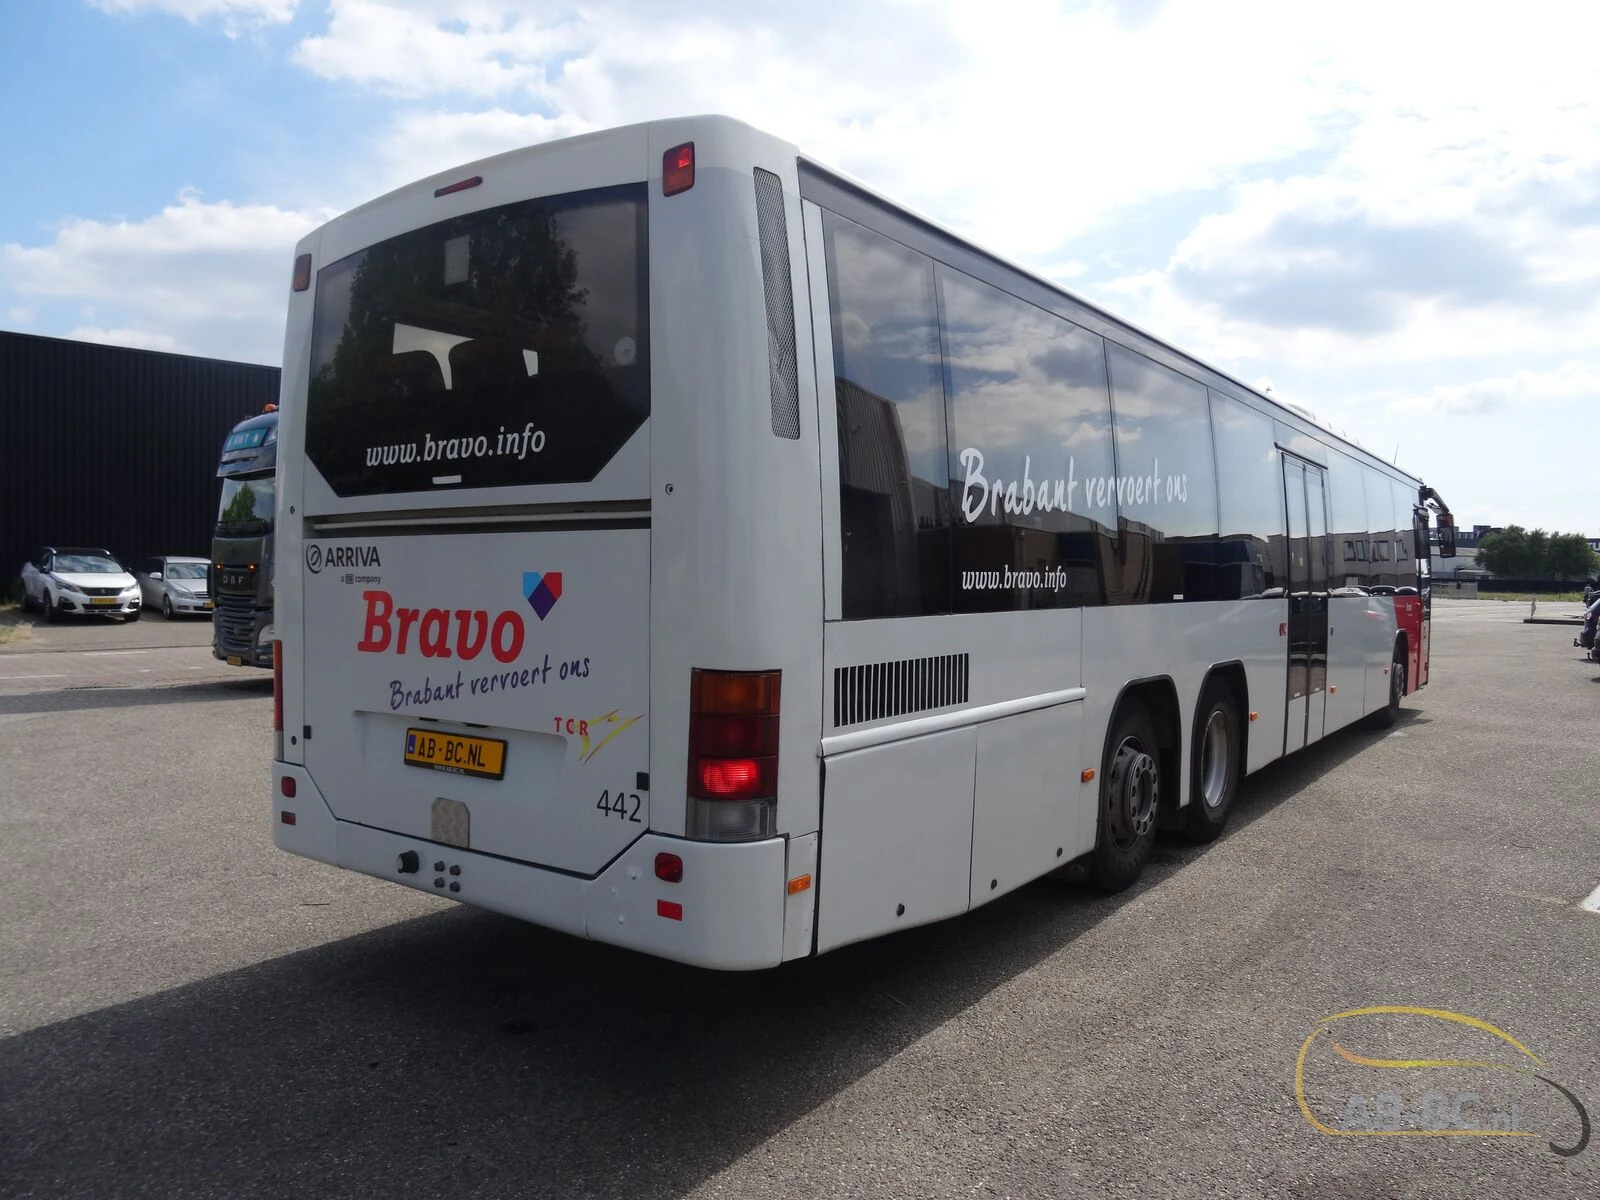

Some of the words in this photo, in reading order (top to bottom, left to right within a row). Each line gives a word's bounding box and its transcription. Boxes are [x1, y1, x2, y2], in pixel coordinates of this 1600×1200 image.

[365, 422, 546, 466] www.bravo.info
[960, 447, 1078, 523] Brabant
[1085, 457, 1160, 508] vervoert
[1166, 473, 1188, 503] ons
[325, 546, 381, 567] ARRIVA
[223, 575, 245, 584] DAF
[355, 575, 381, 585] company
[962, 564, 1067, 593] www.bravo.info
[357, 590, 525, 663] Bravo
[390, 671, 464, 710] Brabant
[471, 654, 552, 695] vervoert
[559, 656, 590, 681] ons
[554, 717, 588, 736] TCR
[597, 790, 641, 823] 442
